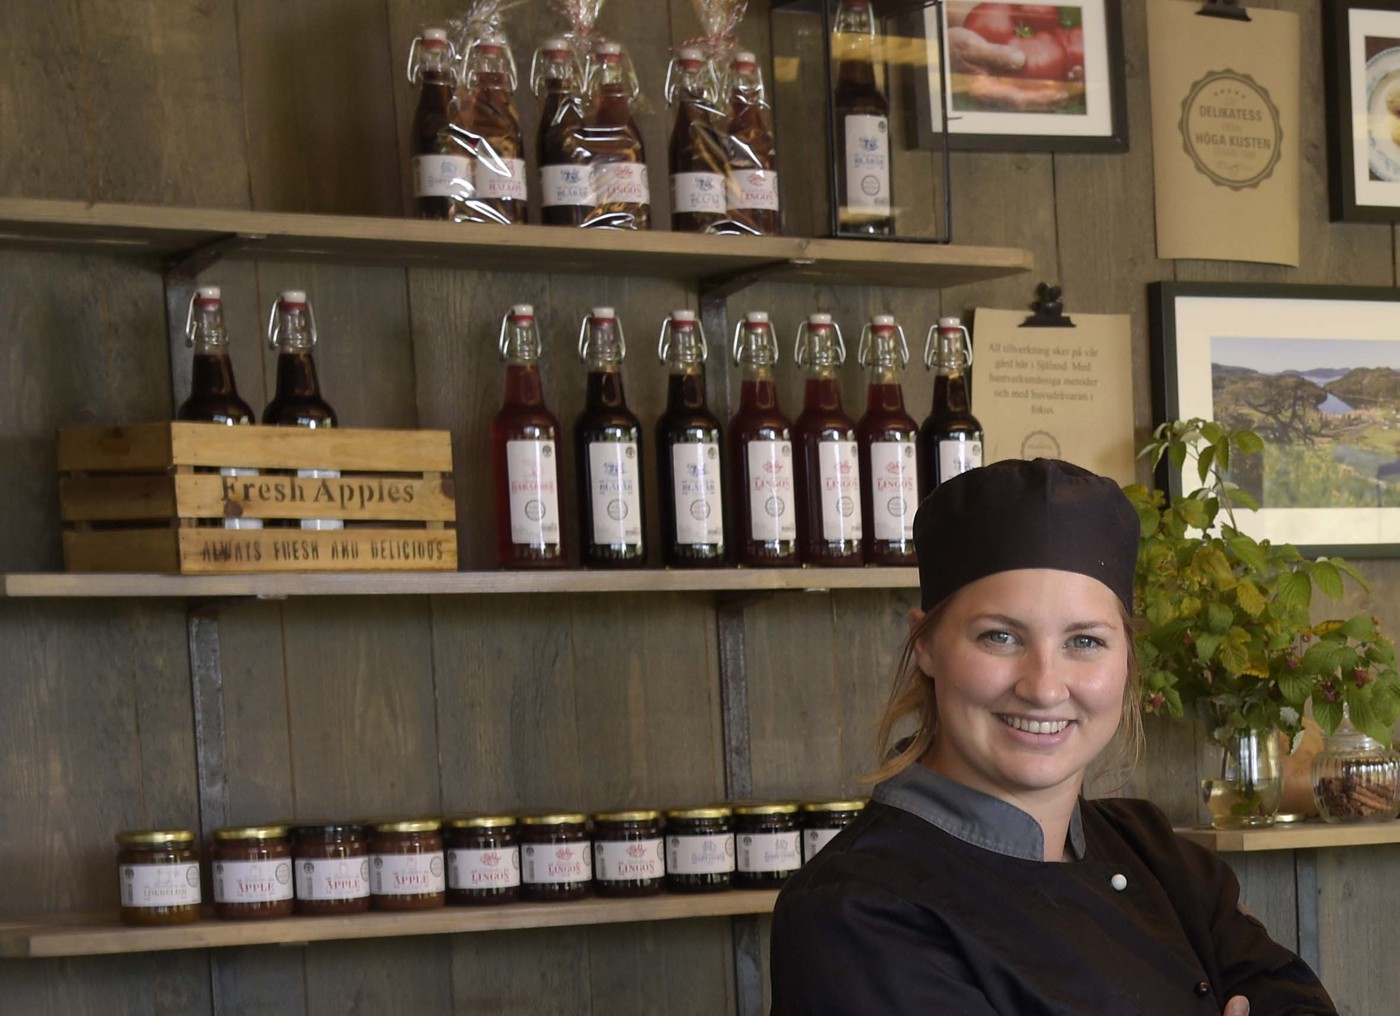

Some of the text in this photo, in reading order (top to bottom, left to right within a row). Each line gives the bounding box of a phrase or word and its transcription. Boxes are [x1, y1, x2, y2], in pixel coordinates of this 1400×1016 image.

[1199, 105, 1263, 122] DELIKATESS
[1195, 131, 1271, 150] HÖGA KUSTEN
[220, 474, 415, 510] Fresh Apples
[202, 539, 444, 563] ALWAYS FRESH AND DELICIOUS
[471, 868, 511, 884] LINGON
[548, 862, 582, 877] LINGON
[618, 861, 656, 877] LINGON
